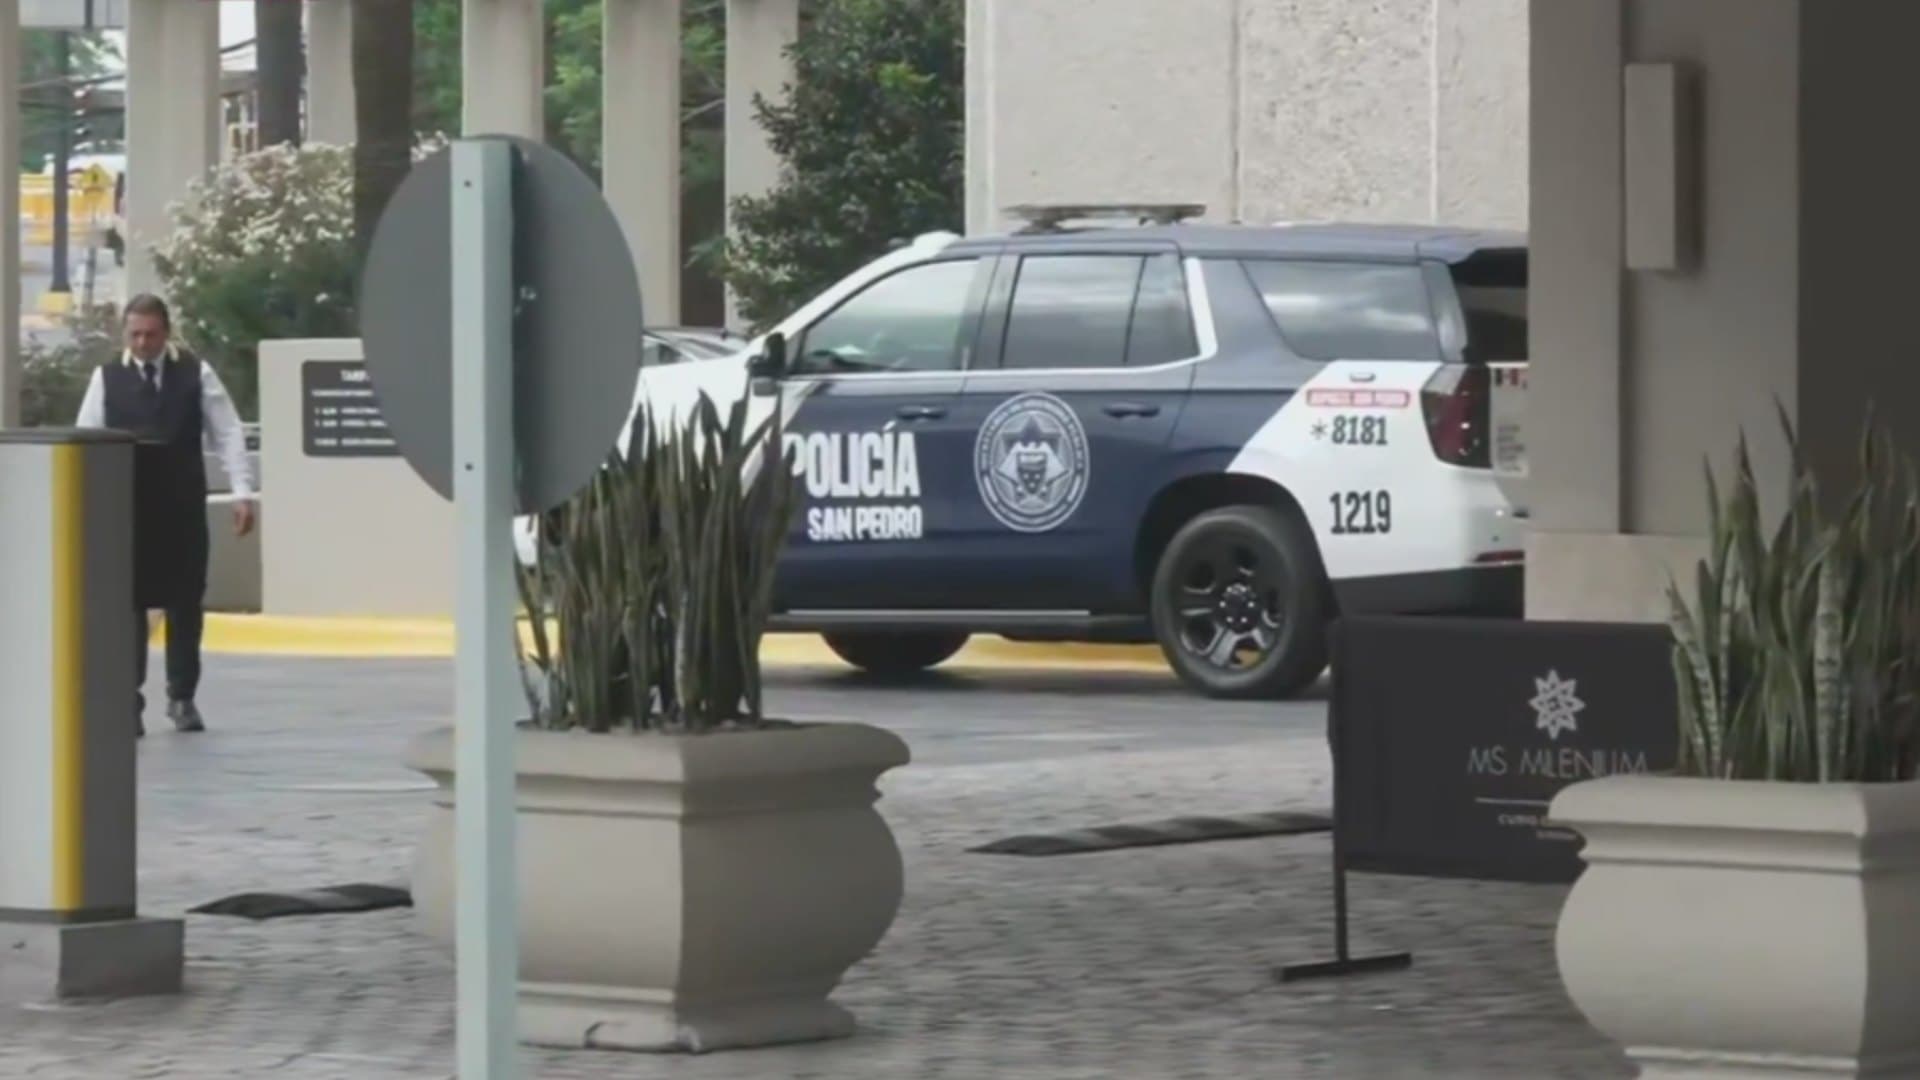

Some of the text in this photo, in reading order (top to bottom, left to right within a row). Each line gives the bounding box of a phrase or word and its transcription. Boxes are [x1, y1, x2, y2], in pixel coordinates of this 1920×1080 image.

[781, 420, 921, 499] POLICÍA
[807, 504, 923, 541] SAN PEDRO
[1329, 489, 1391, 534] 1219
[1467, 745, 1508, 776] MS
